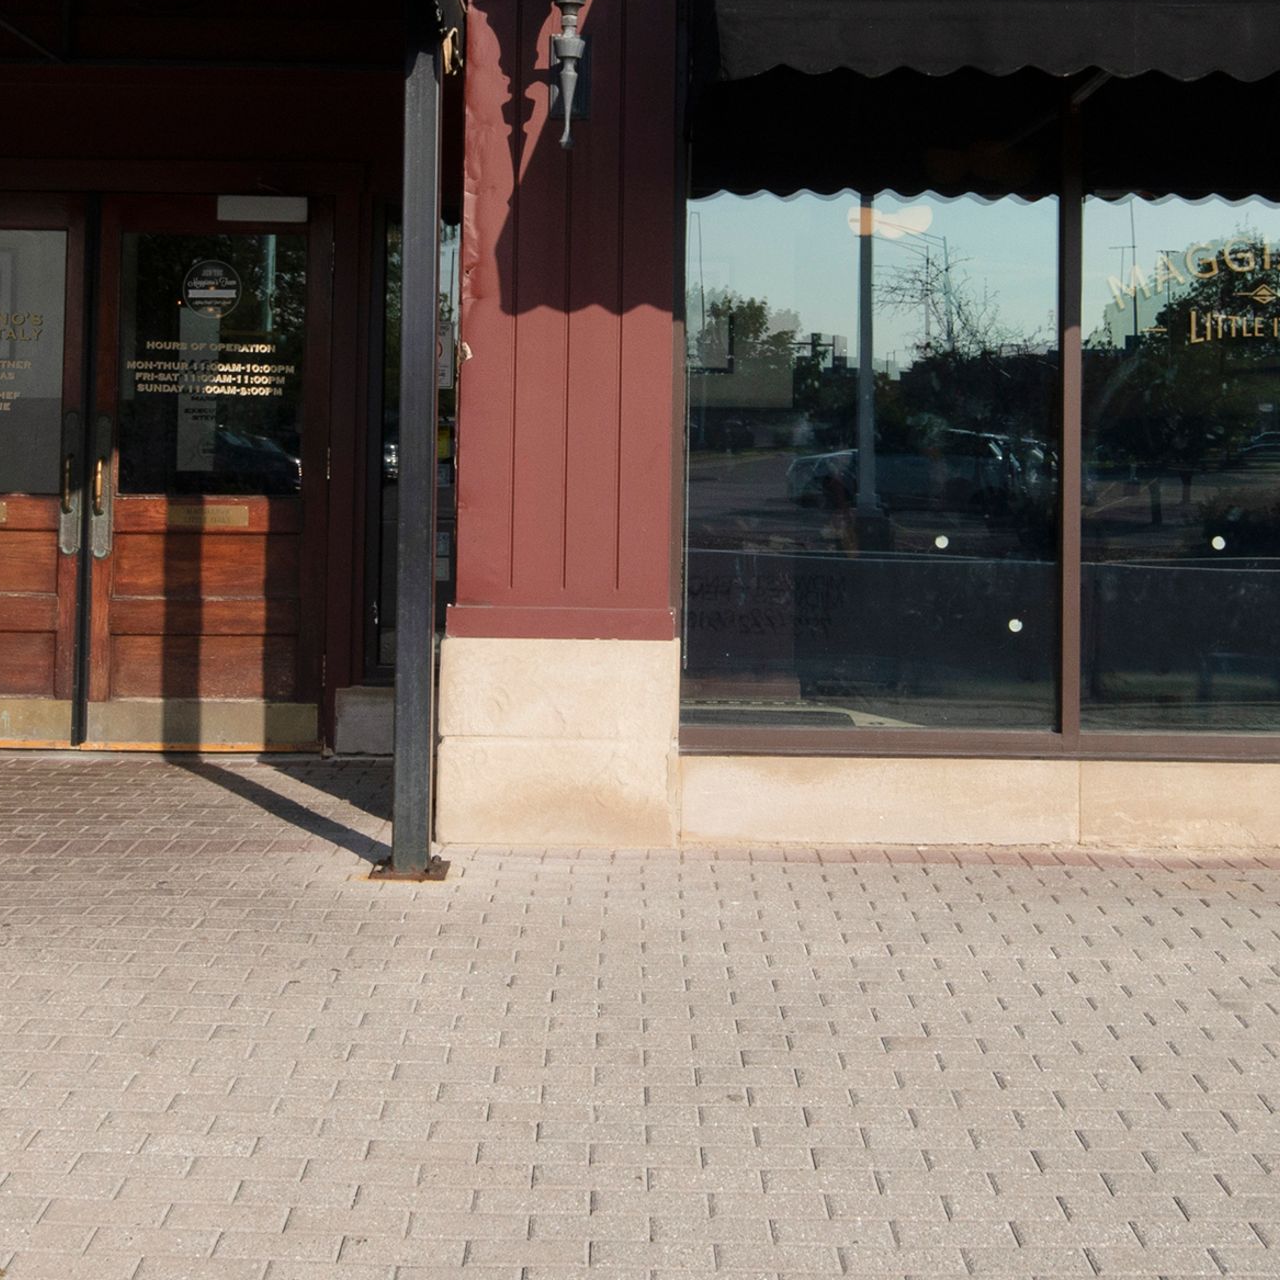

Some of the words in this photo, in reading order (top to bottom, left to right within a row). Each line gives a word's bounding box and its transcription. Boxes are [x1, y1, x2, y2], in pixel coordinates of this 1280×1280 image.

[1189, 309, 1266, 345] LITTLE
[146, 341, 187, 350] HOURS
[191, 342, 206, 351] OF
[209, 342, 276, 353] OPERATION
[126, 360, 189, 371] MON-THUR
[135, 371, 180, 382] FRI-SAT
[136, 383, 185, 393] SUNDAY
